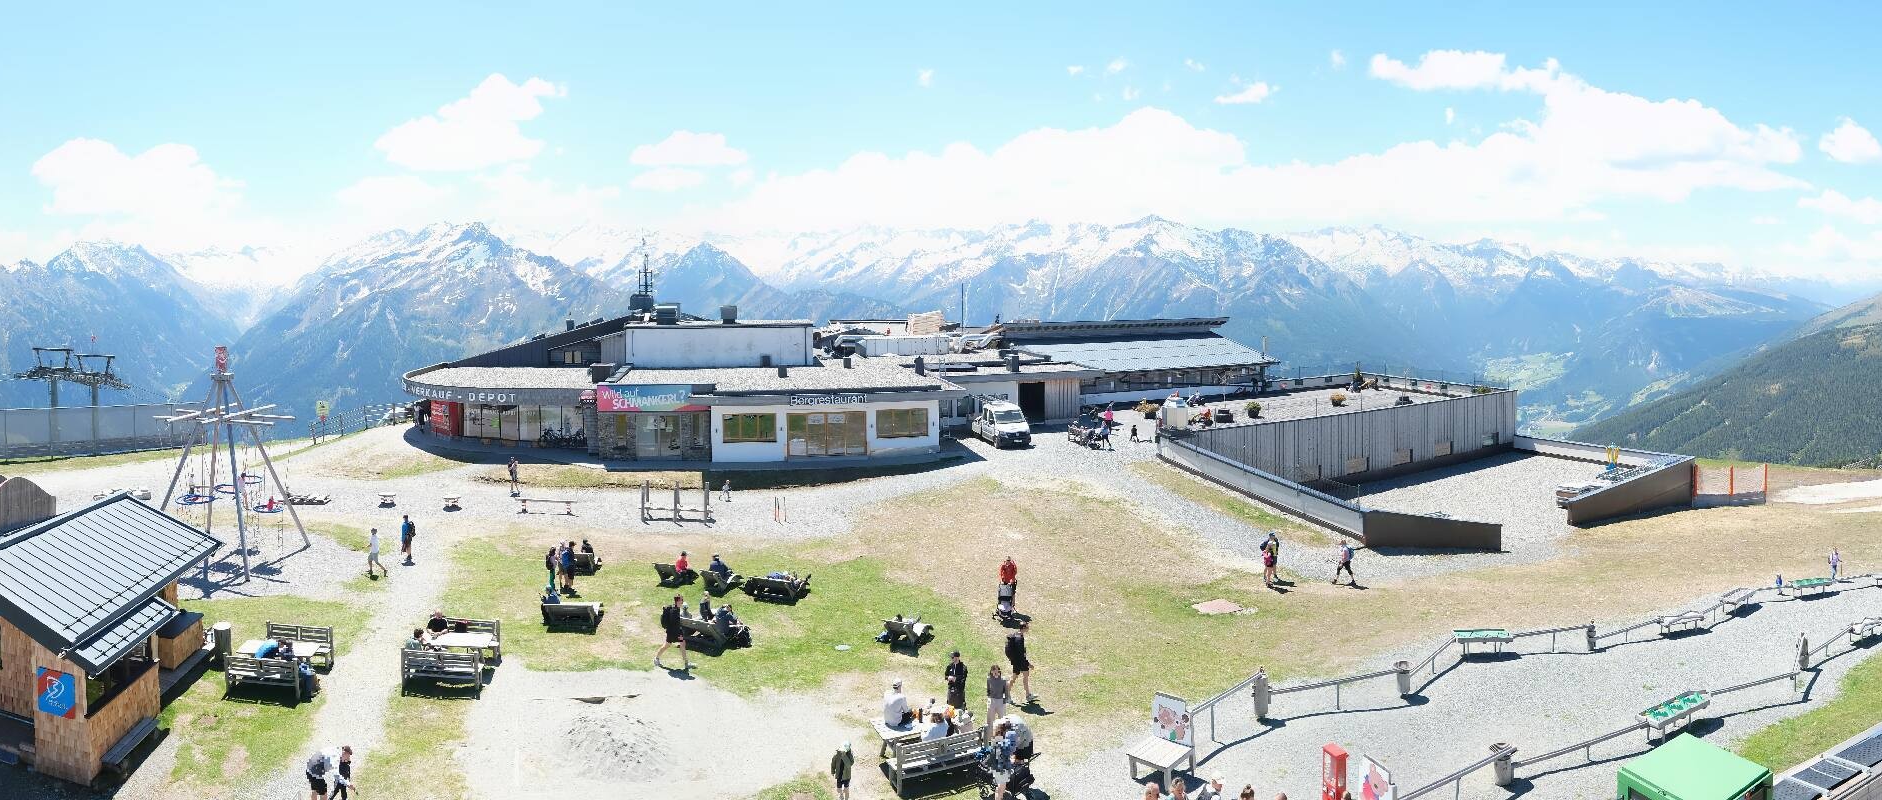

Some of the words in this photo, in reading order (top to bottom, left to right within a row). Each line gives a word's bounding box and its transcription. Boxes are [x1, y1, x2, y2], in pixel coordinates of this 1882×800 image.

[411, 386, 452, 399] VERKAUF
[468, 392, 516, 402] DEPOT
[602, 388, 621, 400] Wild
[624, 386, 639, 398] auf
[612, 389, 686, 409] SCHMANKERL?
[790, 394, 867, 405] Bergrestaurant
